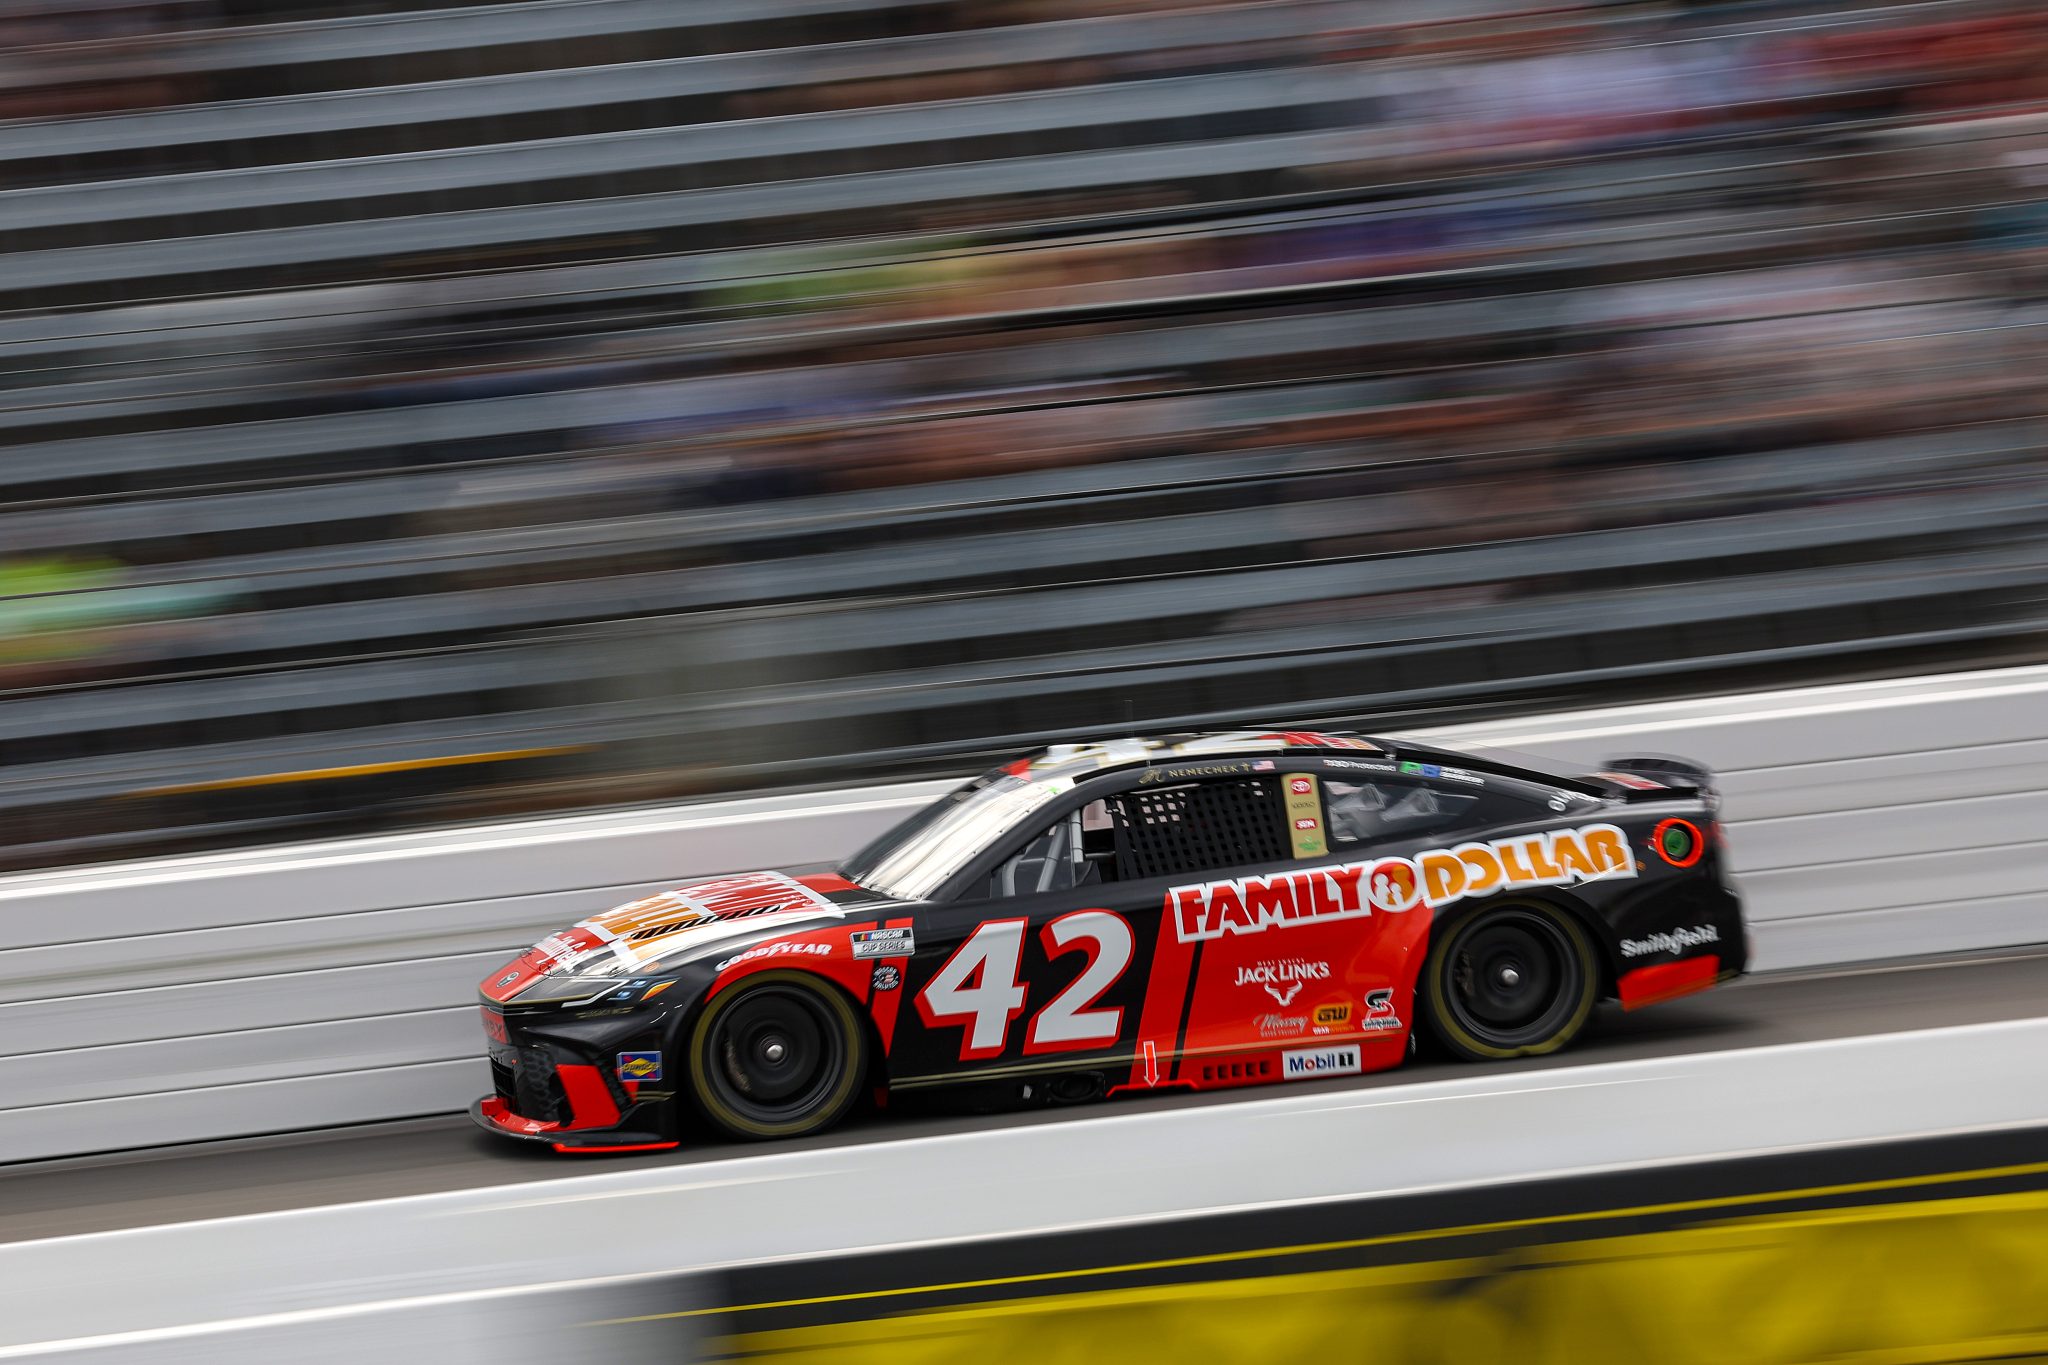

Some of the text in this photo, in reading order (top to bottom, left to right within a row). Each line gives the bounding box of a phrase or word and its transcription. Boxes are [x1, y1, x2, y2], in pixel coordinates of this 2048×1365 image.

[1168, 765, 1239, 778] NEMECHEK
[1415, 826, 1636, 906] DOLLAR
[1170, 862, 1371, 942] FAMILY
[871, 929, 904, 941] NASCAR
[1620, 924, 1719, 957] Smithfield
[715, 941, 832, 972] GOODYEAR
[916, 908, 1135, 1058] 42
[1235, 966, 1278, 986] JACK
[1289, 1053, 1335, 1072] Mobil
